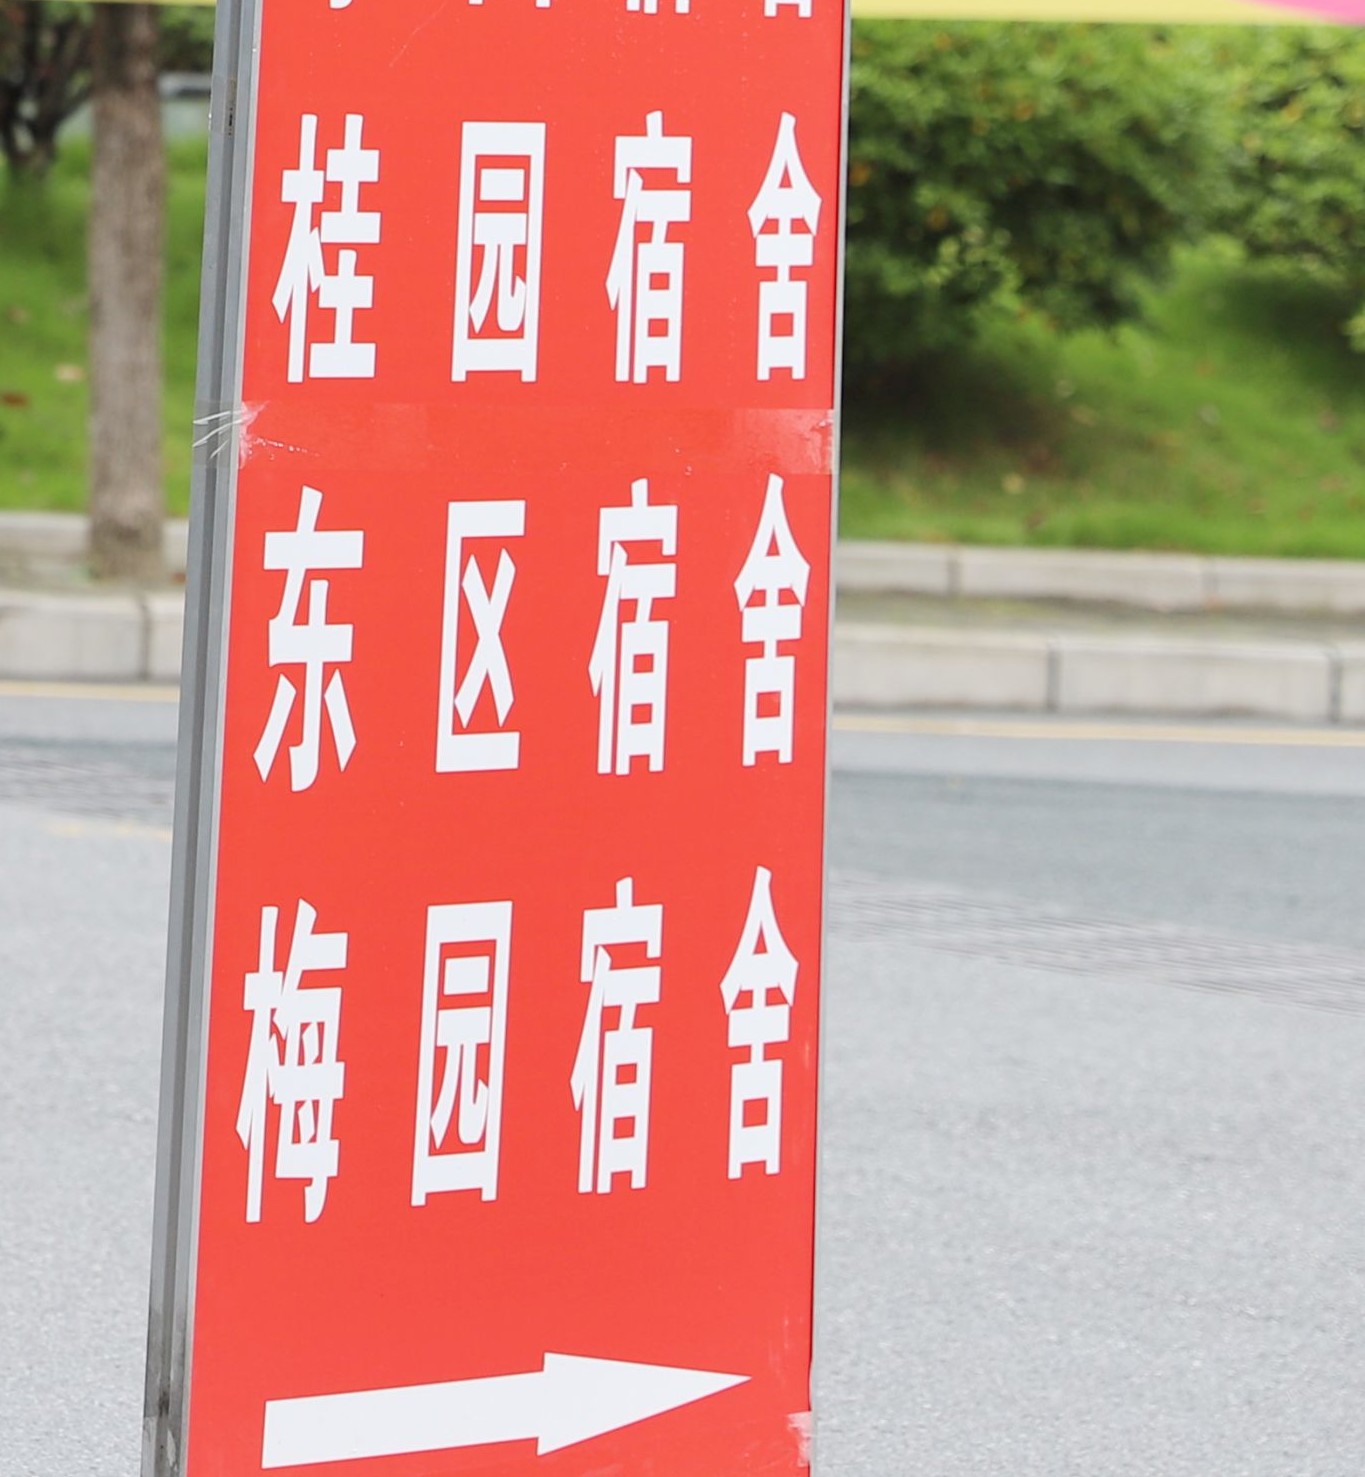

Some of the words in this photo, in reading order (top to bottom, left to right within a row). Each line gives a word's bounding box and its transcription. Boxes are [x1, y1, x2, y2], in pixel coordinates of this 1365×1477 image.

[272, 110, 822, 384] 桂园宿舍
[253, 473, 811, 792] 东区宿舍
[235, 865, 800, 1224] 梅园宿舍
